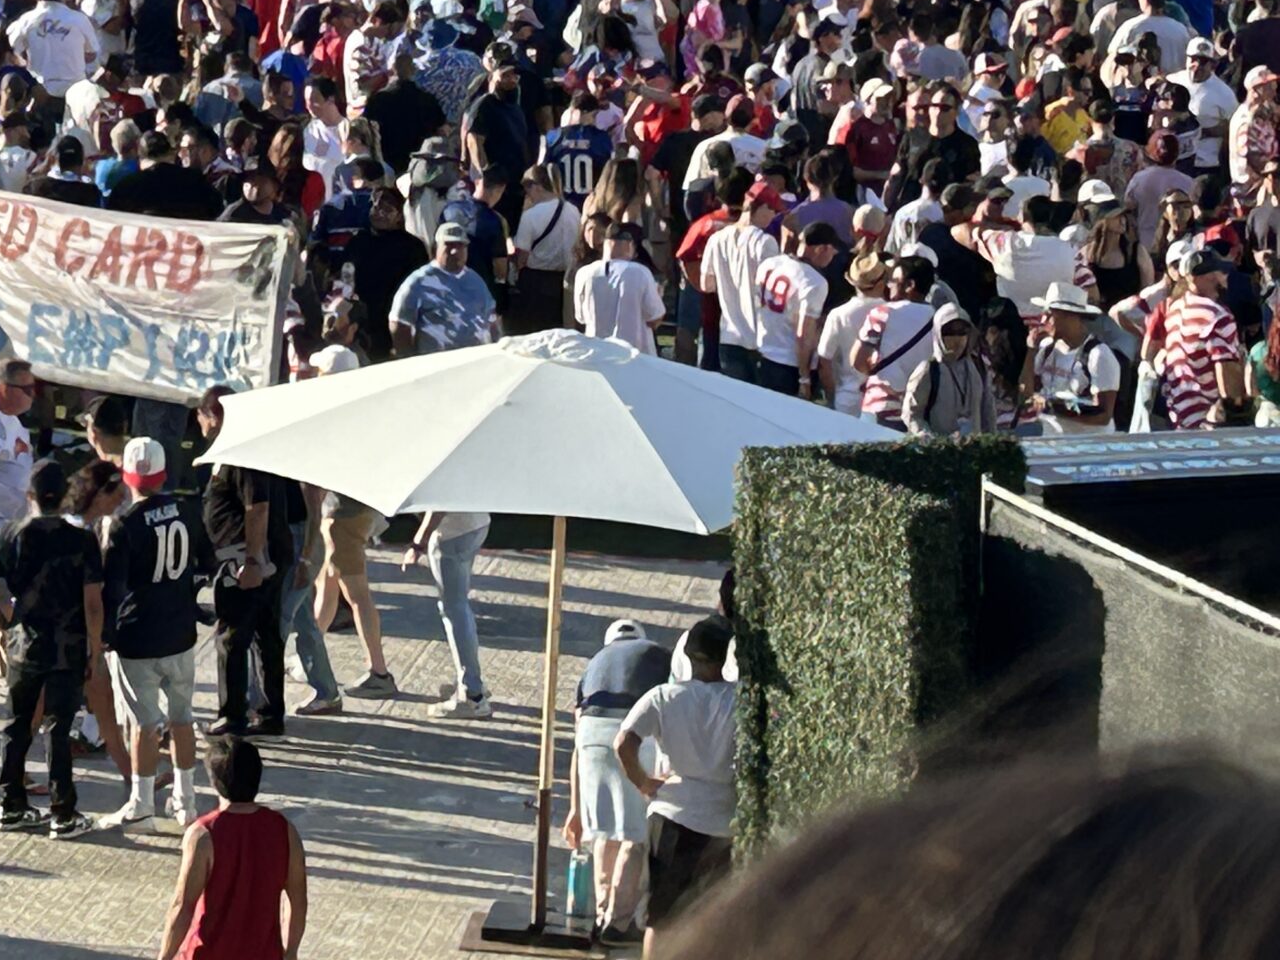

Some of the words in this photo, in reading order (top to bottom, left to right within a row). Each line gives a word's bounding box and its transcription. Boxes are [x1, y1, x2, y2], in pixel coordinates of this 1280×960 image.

[561, 153, 593, 195] 10
[54, 217, 206, 294] CARD
[151, 519, 190, 583] 10
